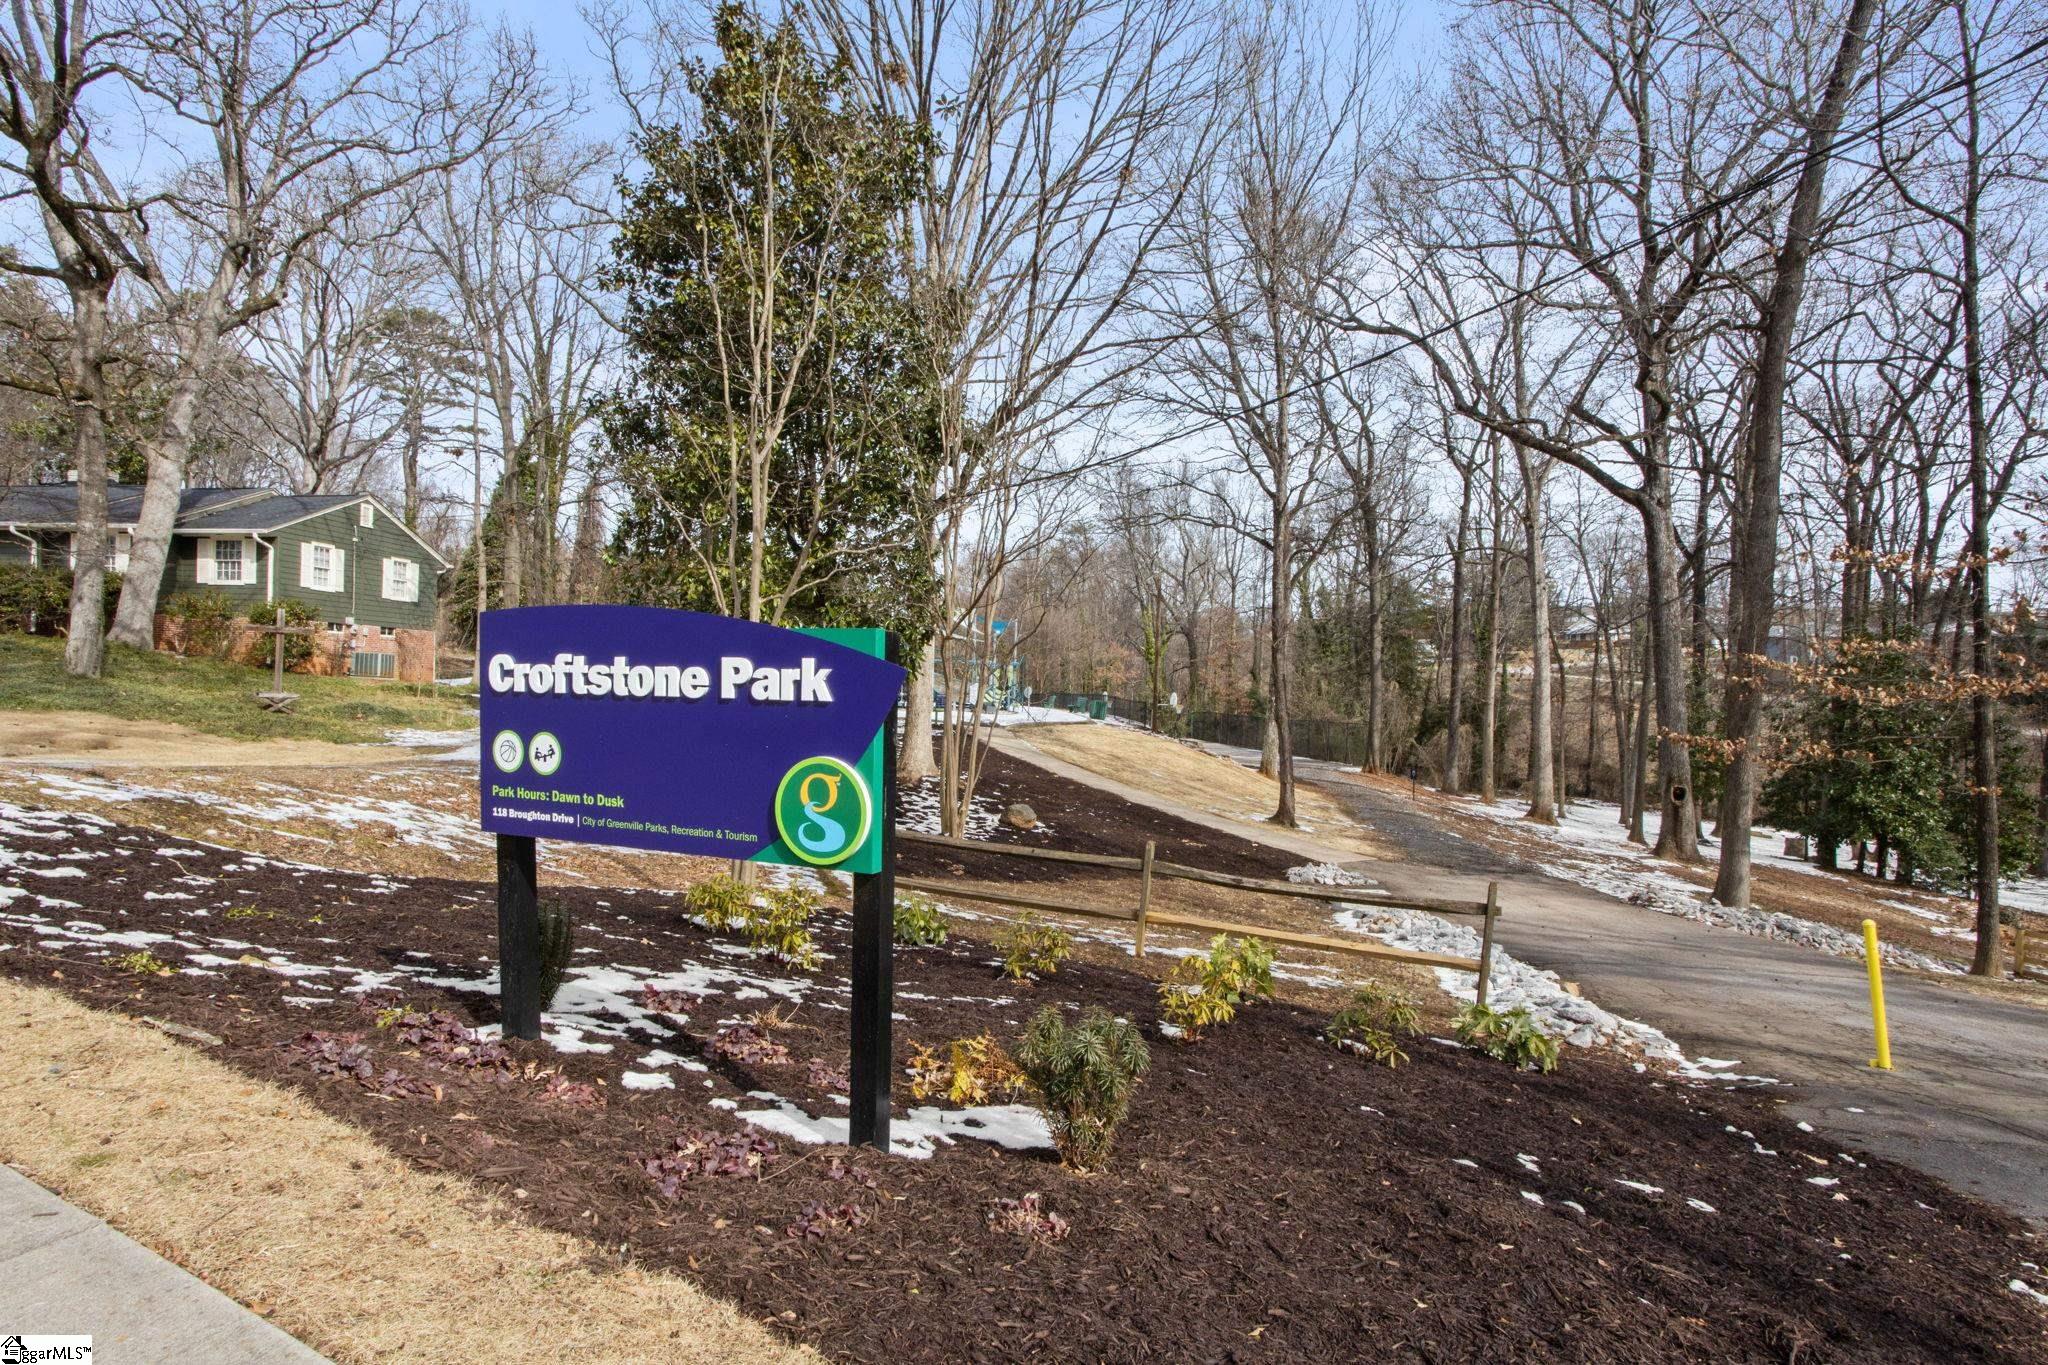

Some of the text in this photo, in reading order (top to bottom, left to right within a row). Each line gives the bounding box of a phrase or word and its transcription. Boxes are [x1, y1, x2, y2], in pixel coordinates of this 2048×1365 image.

[488, 653, 834, 702] Croftstone Park
[492, 785, 624, 808] Park Hours: Dawn to Dusk
[492, 807, 574, 824] 118 Broughton Drive
[582, 816, 758, 842] City of Greenville Parks, Recreation & Tourism
